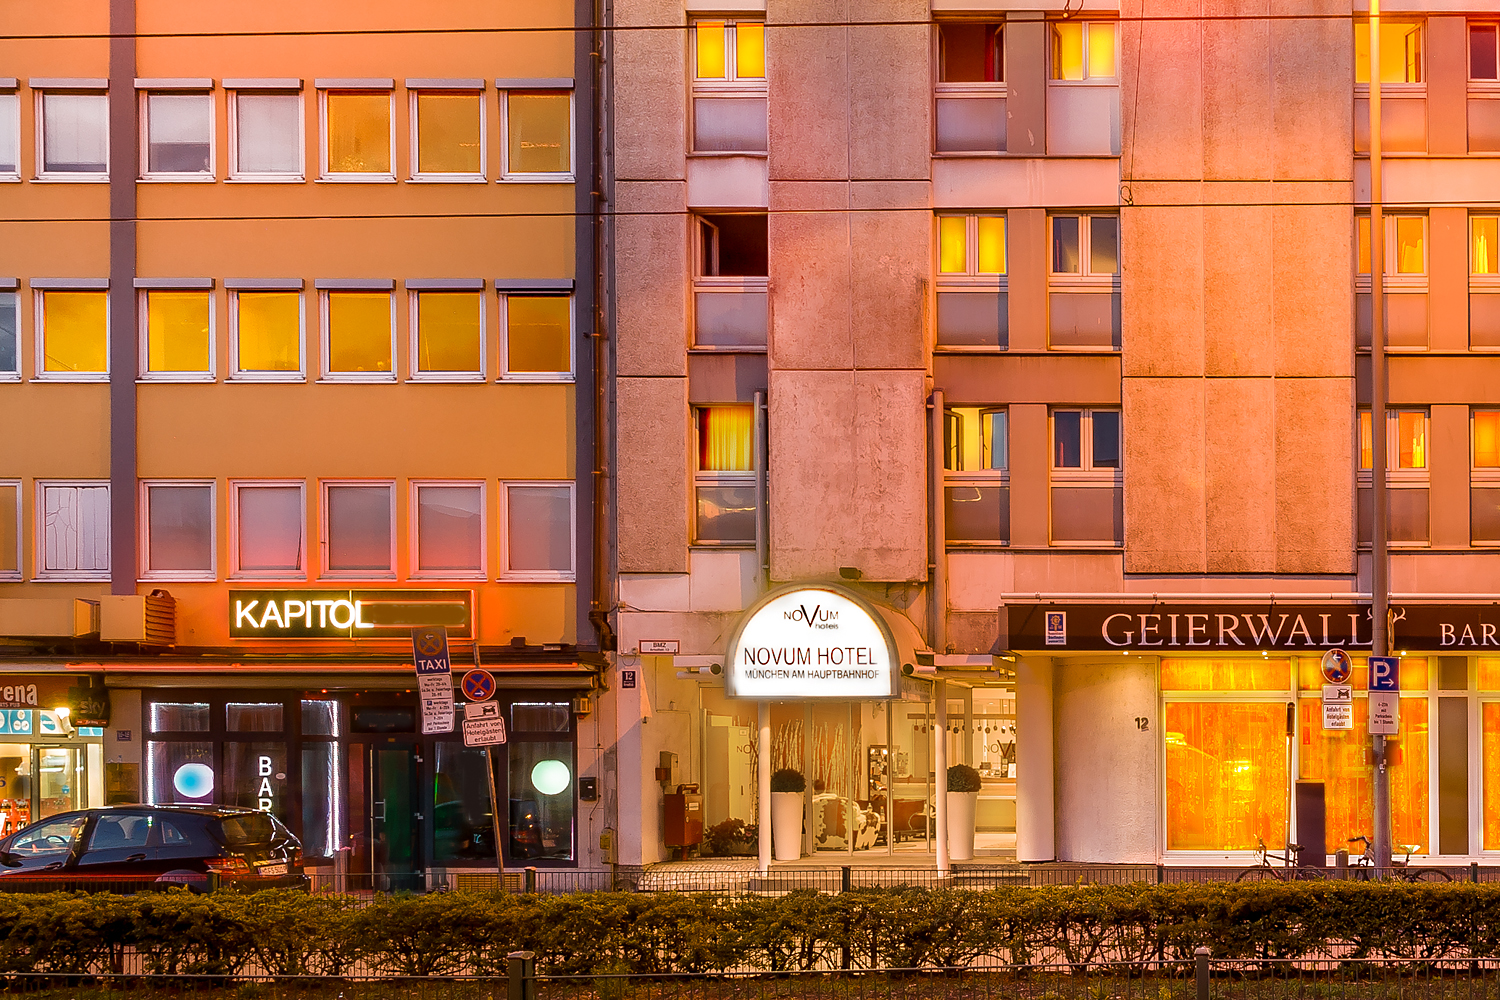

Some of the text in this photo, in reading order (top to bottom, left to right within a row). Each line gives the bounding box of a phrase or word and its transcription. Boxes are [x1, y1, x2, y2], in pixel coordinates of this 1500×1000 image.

[235, 599, 374, 629] KAPITOL
[744, 647, 878, 666] NOVUM HOTEL
[418, 659, 447, 671] TAXI
[625, 672, 634, 681] 12
[744, 668, 880, 680] MÜNCHEN AM HAUPTBAHNHOF
[1373, 661, 1391, 687] P
[80, 696, 106, 719] sky
[466, 720, 501, 730] Anfahrt von
[1134, 716, 1149, 730] 12
[466, 727, 502, 738] Hotelgästen
[474, 735, 497, 743] erlaubt
[258, 756, 274, 812] BAR
